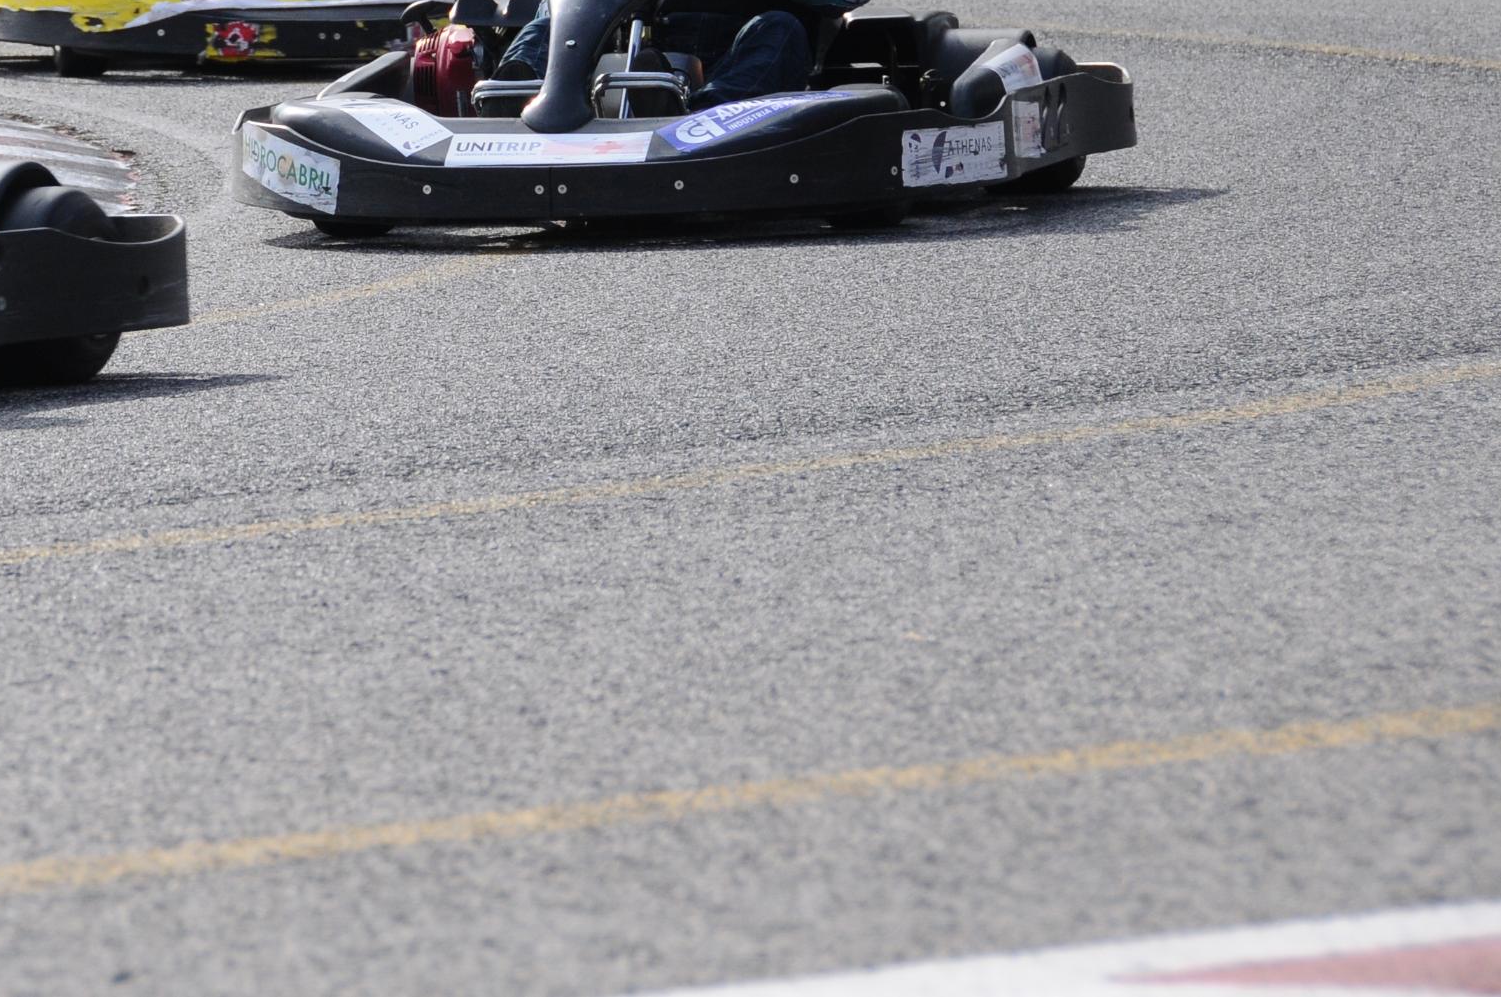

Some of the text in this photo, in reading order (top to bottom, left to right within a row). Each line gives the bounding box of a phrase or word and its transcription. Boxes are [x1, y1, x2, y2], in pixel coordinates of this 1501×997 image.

[727, 108, 772, 131] INDUSTRIA
[456, 141, 542, 153] UNITRIP
[947, 136, 993, 157] ATHENAS
